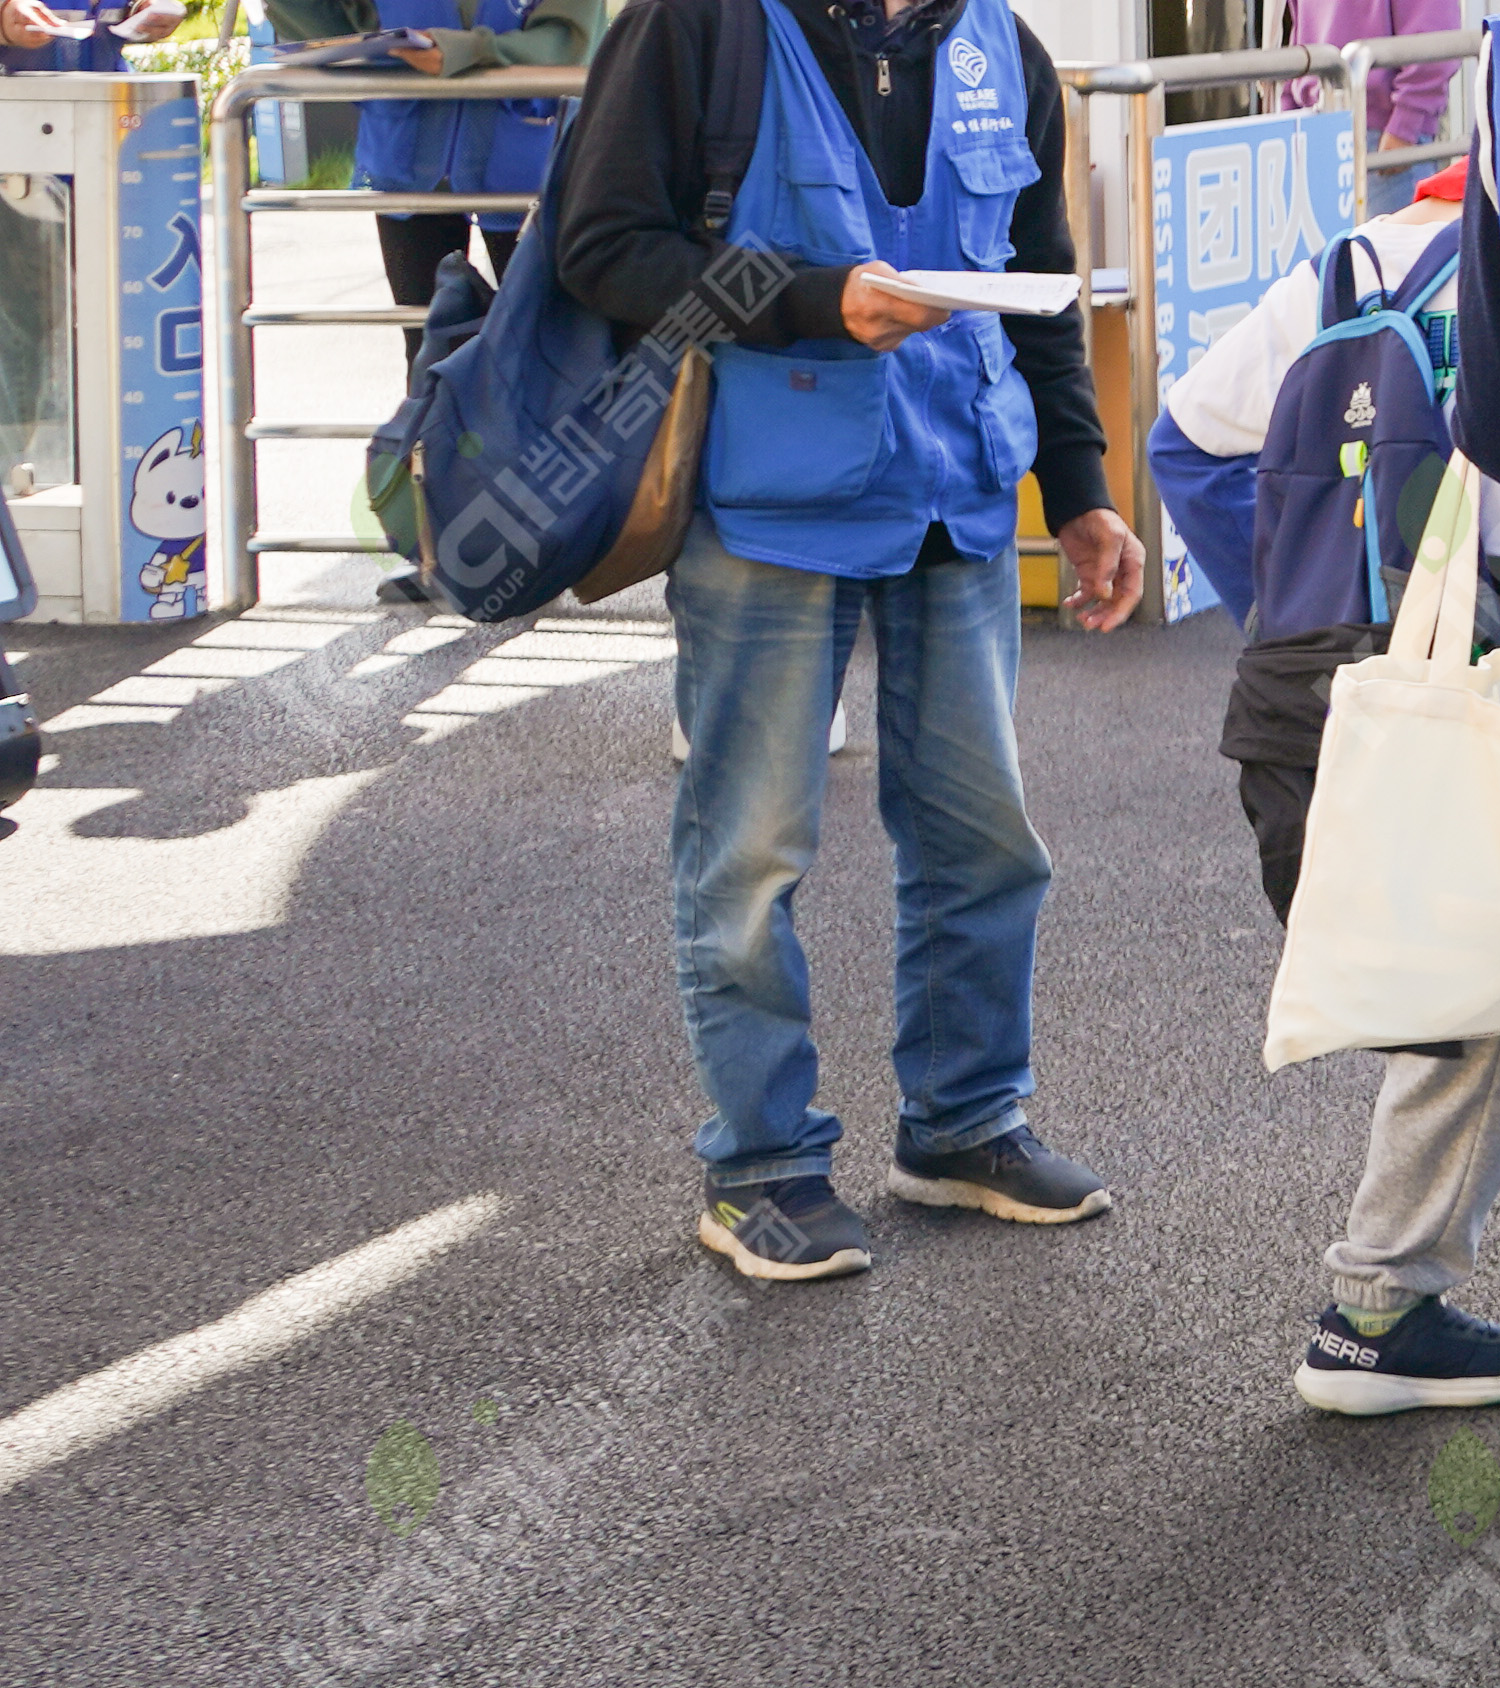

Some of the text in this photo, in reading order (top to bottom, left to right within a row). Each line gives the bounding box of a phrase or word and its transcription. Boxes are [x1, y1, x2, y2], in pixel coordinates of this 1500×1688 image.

[119, 113, 142, 129] 90
[1186, 131, 1327, 293] 团队
[1153, 157, 1174, 289] BEST
[122, 225, 143, 240] 70
[122, 279, 144, 295] 60
[123, 335, 144, 350] 50
[123, 390, 144, 405] 40
[123, 445, 144, 460] 30
